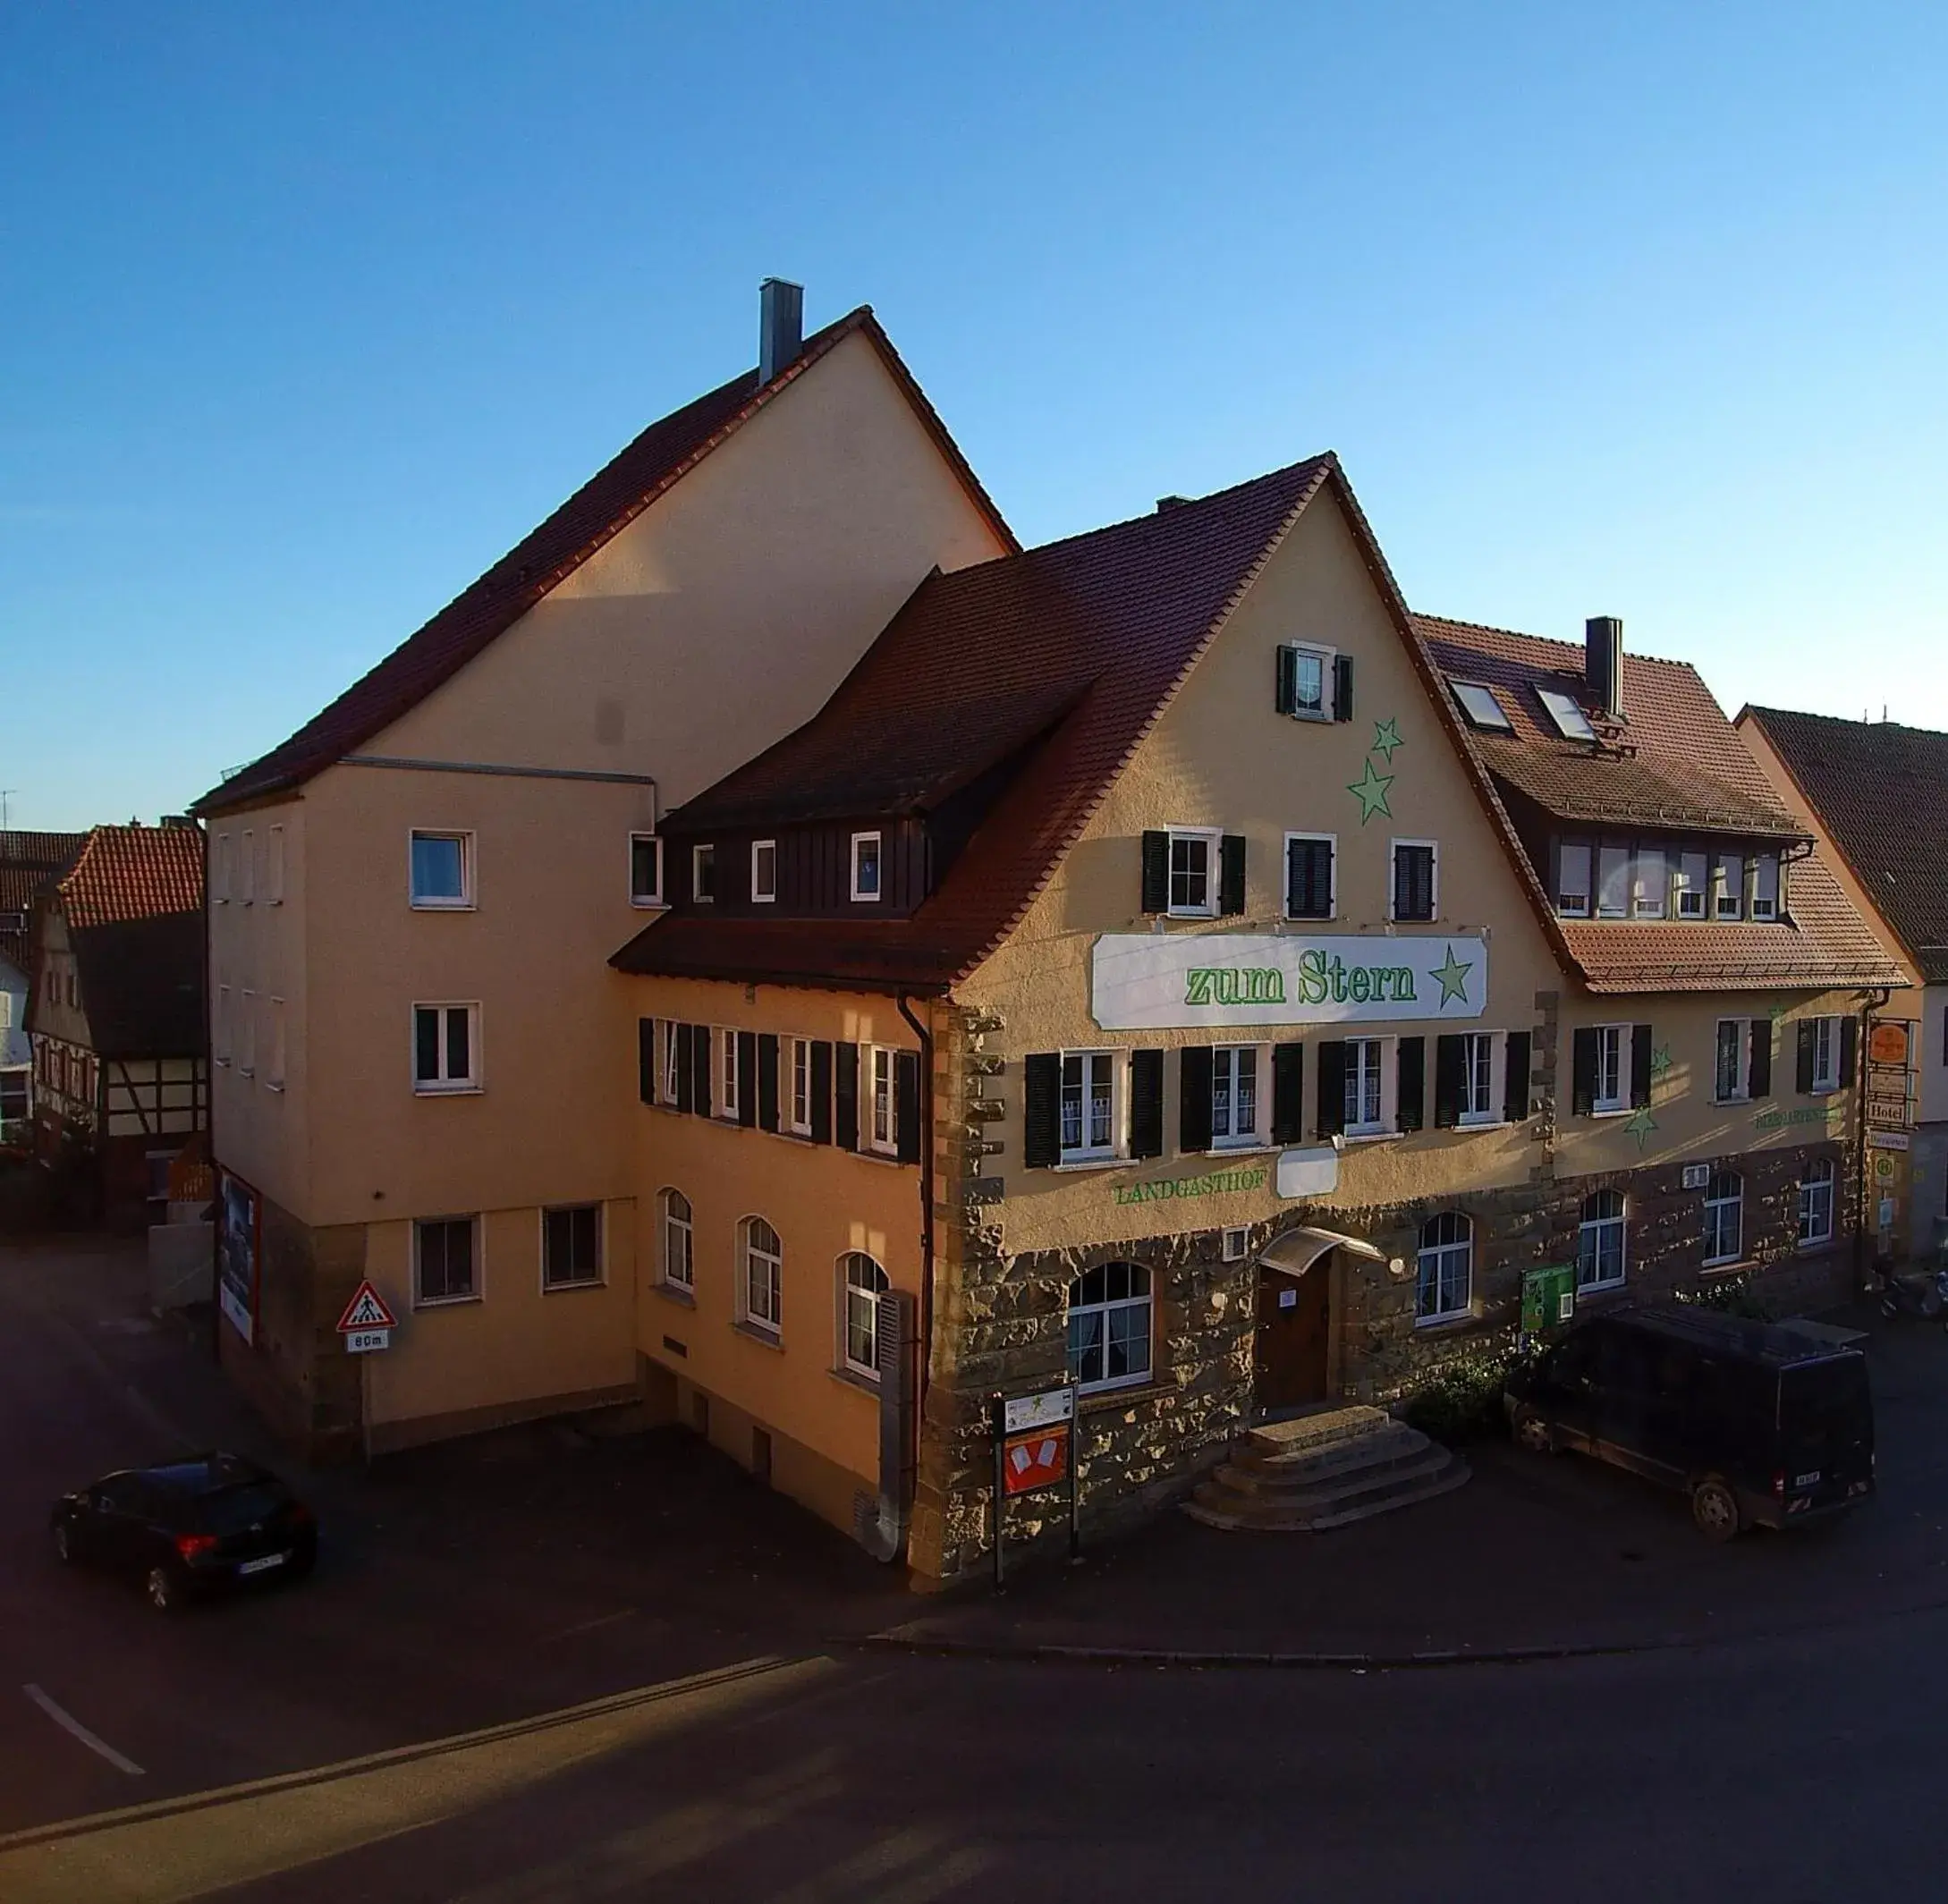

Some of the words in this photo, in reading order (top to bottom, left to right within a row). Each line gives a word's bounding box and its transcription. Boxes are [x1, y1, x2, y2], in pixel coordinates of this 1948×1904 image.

[1184, 966, 1287, 1006] zum
[1298, 949, 1418, 1004] Stern
[1871, 1104, 1903, 1121] Hotel
[1114, 1169, 1268, 1205] LANDGASTHOF
